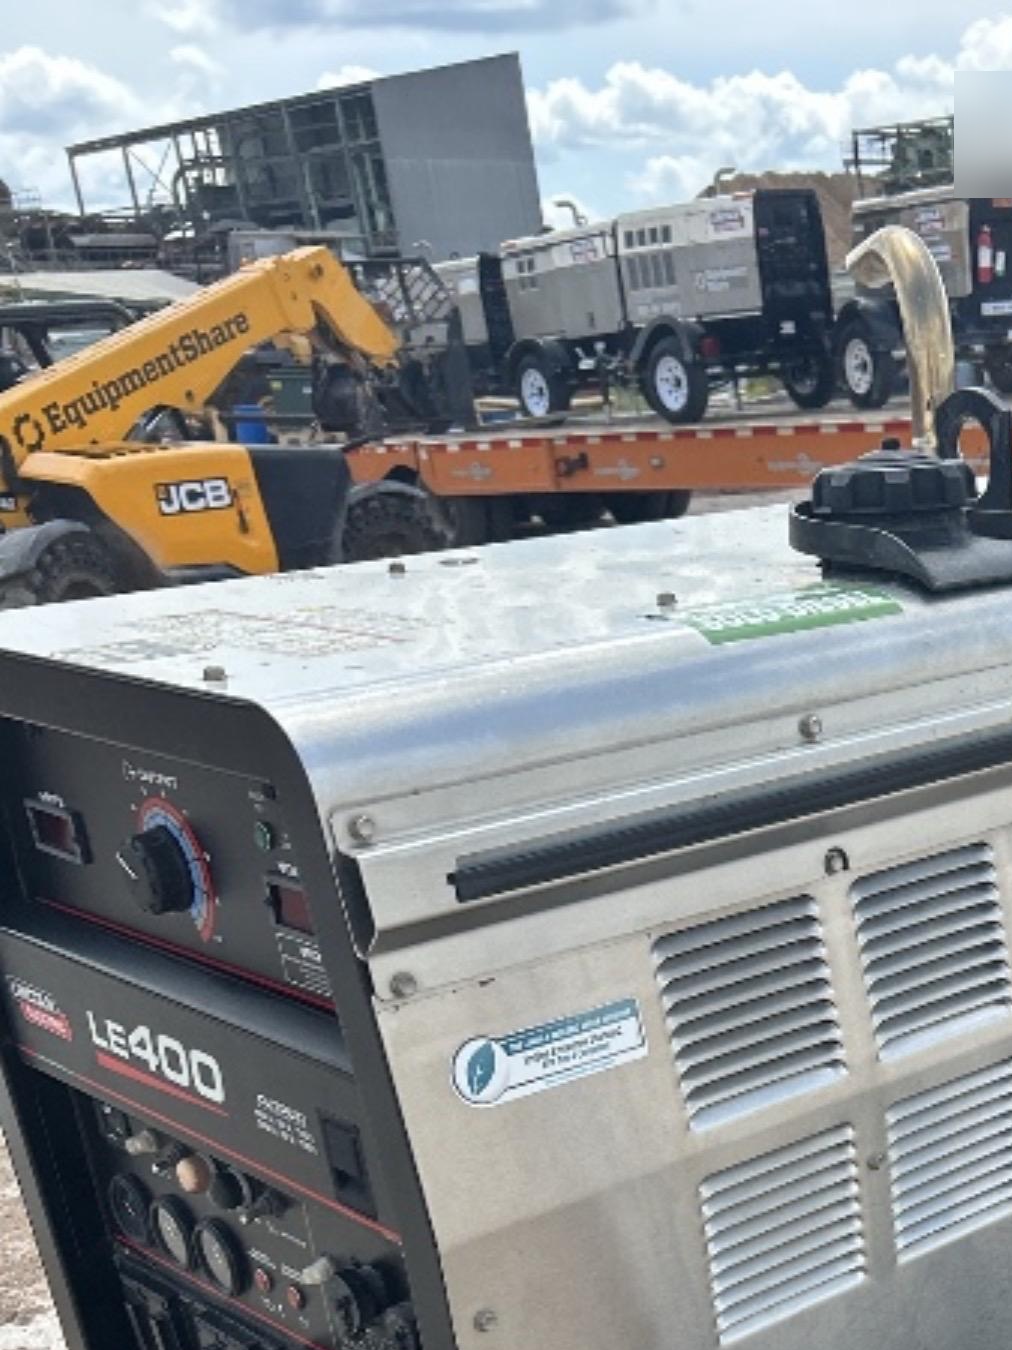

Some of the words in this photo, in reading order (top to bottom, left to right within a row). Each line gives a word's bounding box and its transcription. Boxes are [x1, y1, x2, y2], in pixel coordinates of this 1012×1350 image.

[41, 311, 251, 436] EquipmentShare
[158, 478, 233, 515] JCB
[84, 1009, 226, 1105] LE400
